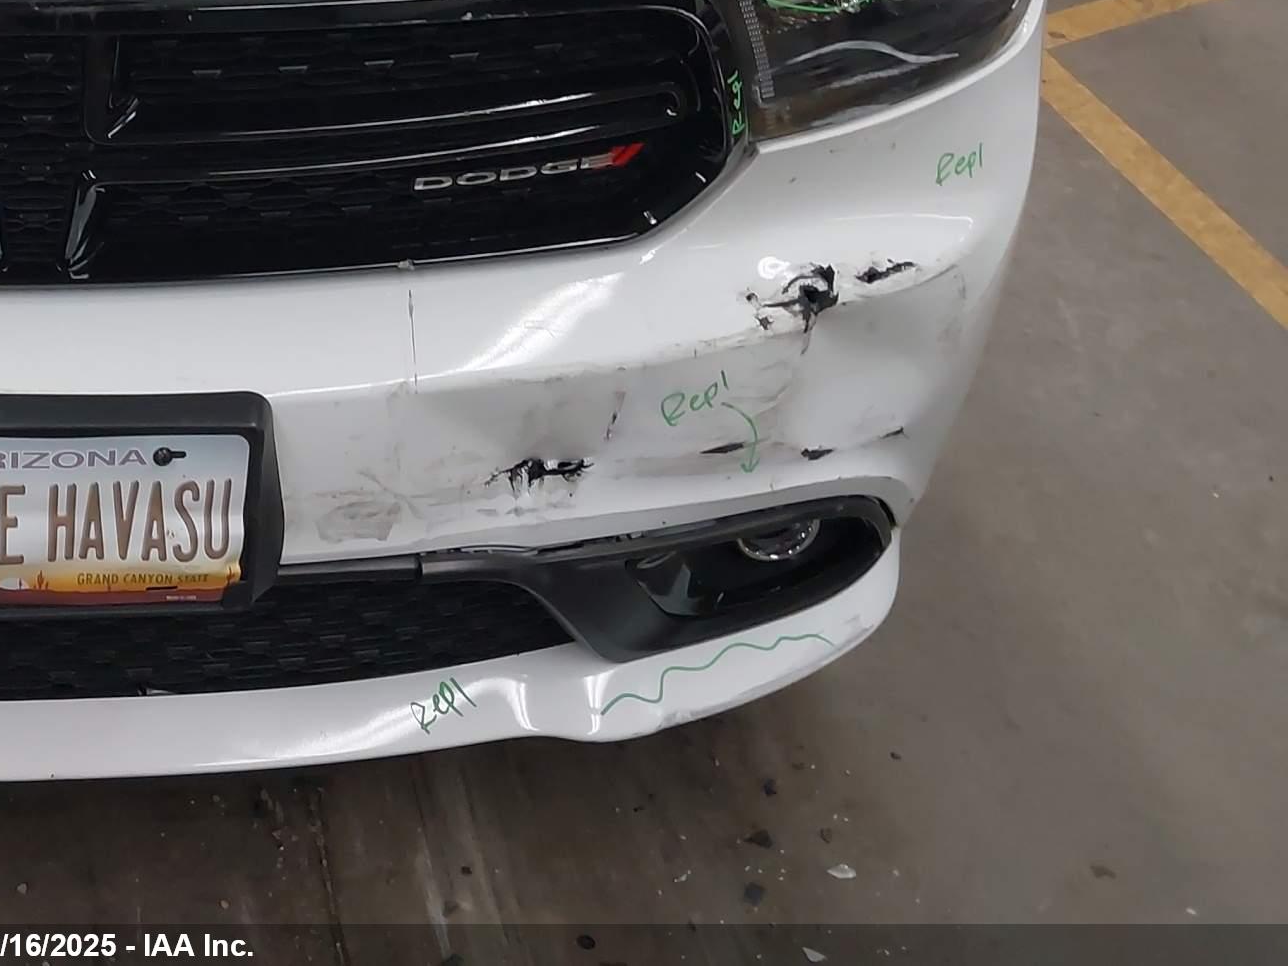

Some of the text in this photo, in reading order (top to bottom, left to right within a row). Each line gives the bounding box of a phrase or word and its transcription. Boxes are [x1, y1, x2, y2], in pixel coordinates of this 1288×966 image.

[413, 151, 618, 191] DODGE
[47, 479, 232, 563] HAVASU
[77, 573, 209, 585] GRAND CANYON STATE
